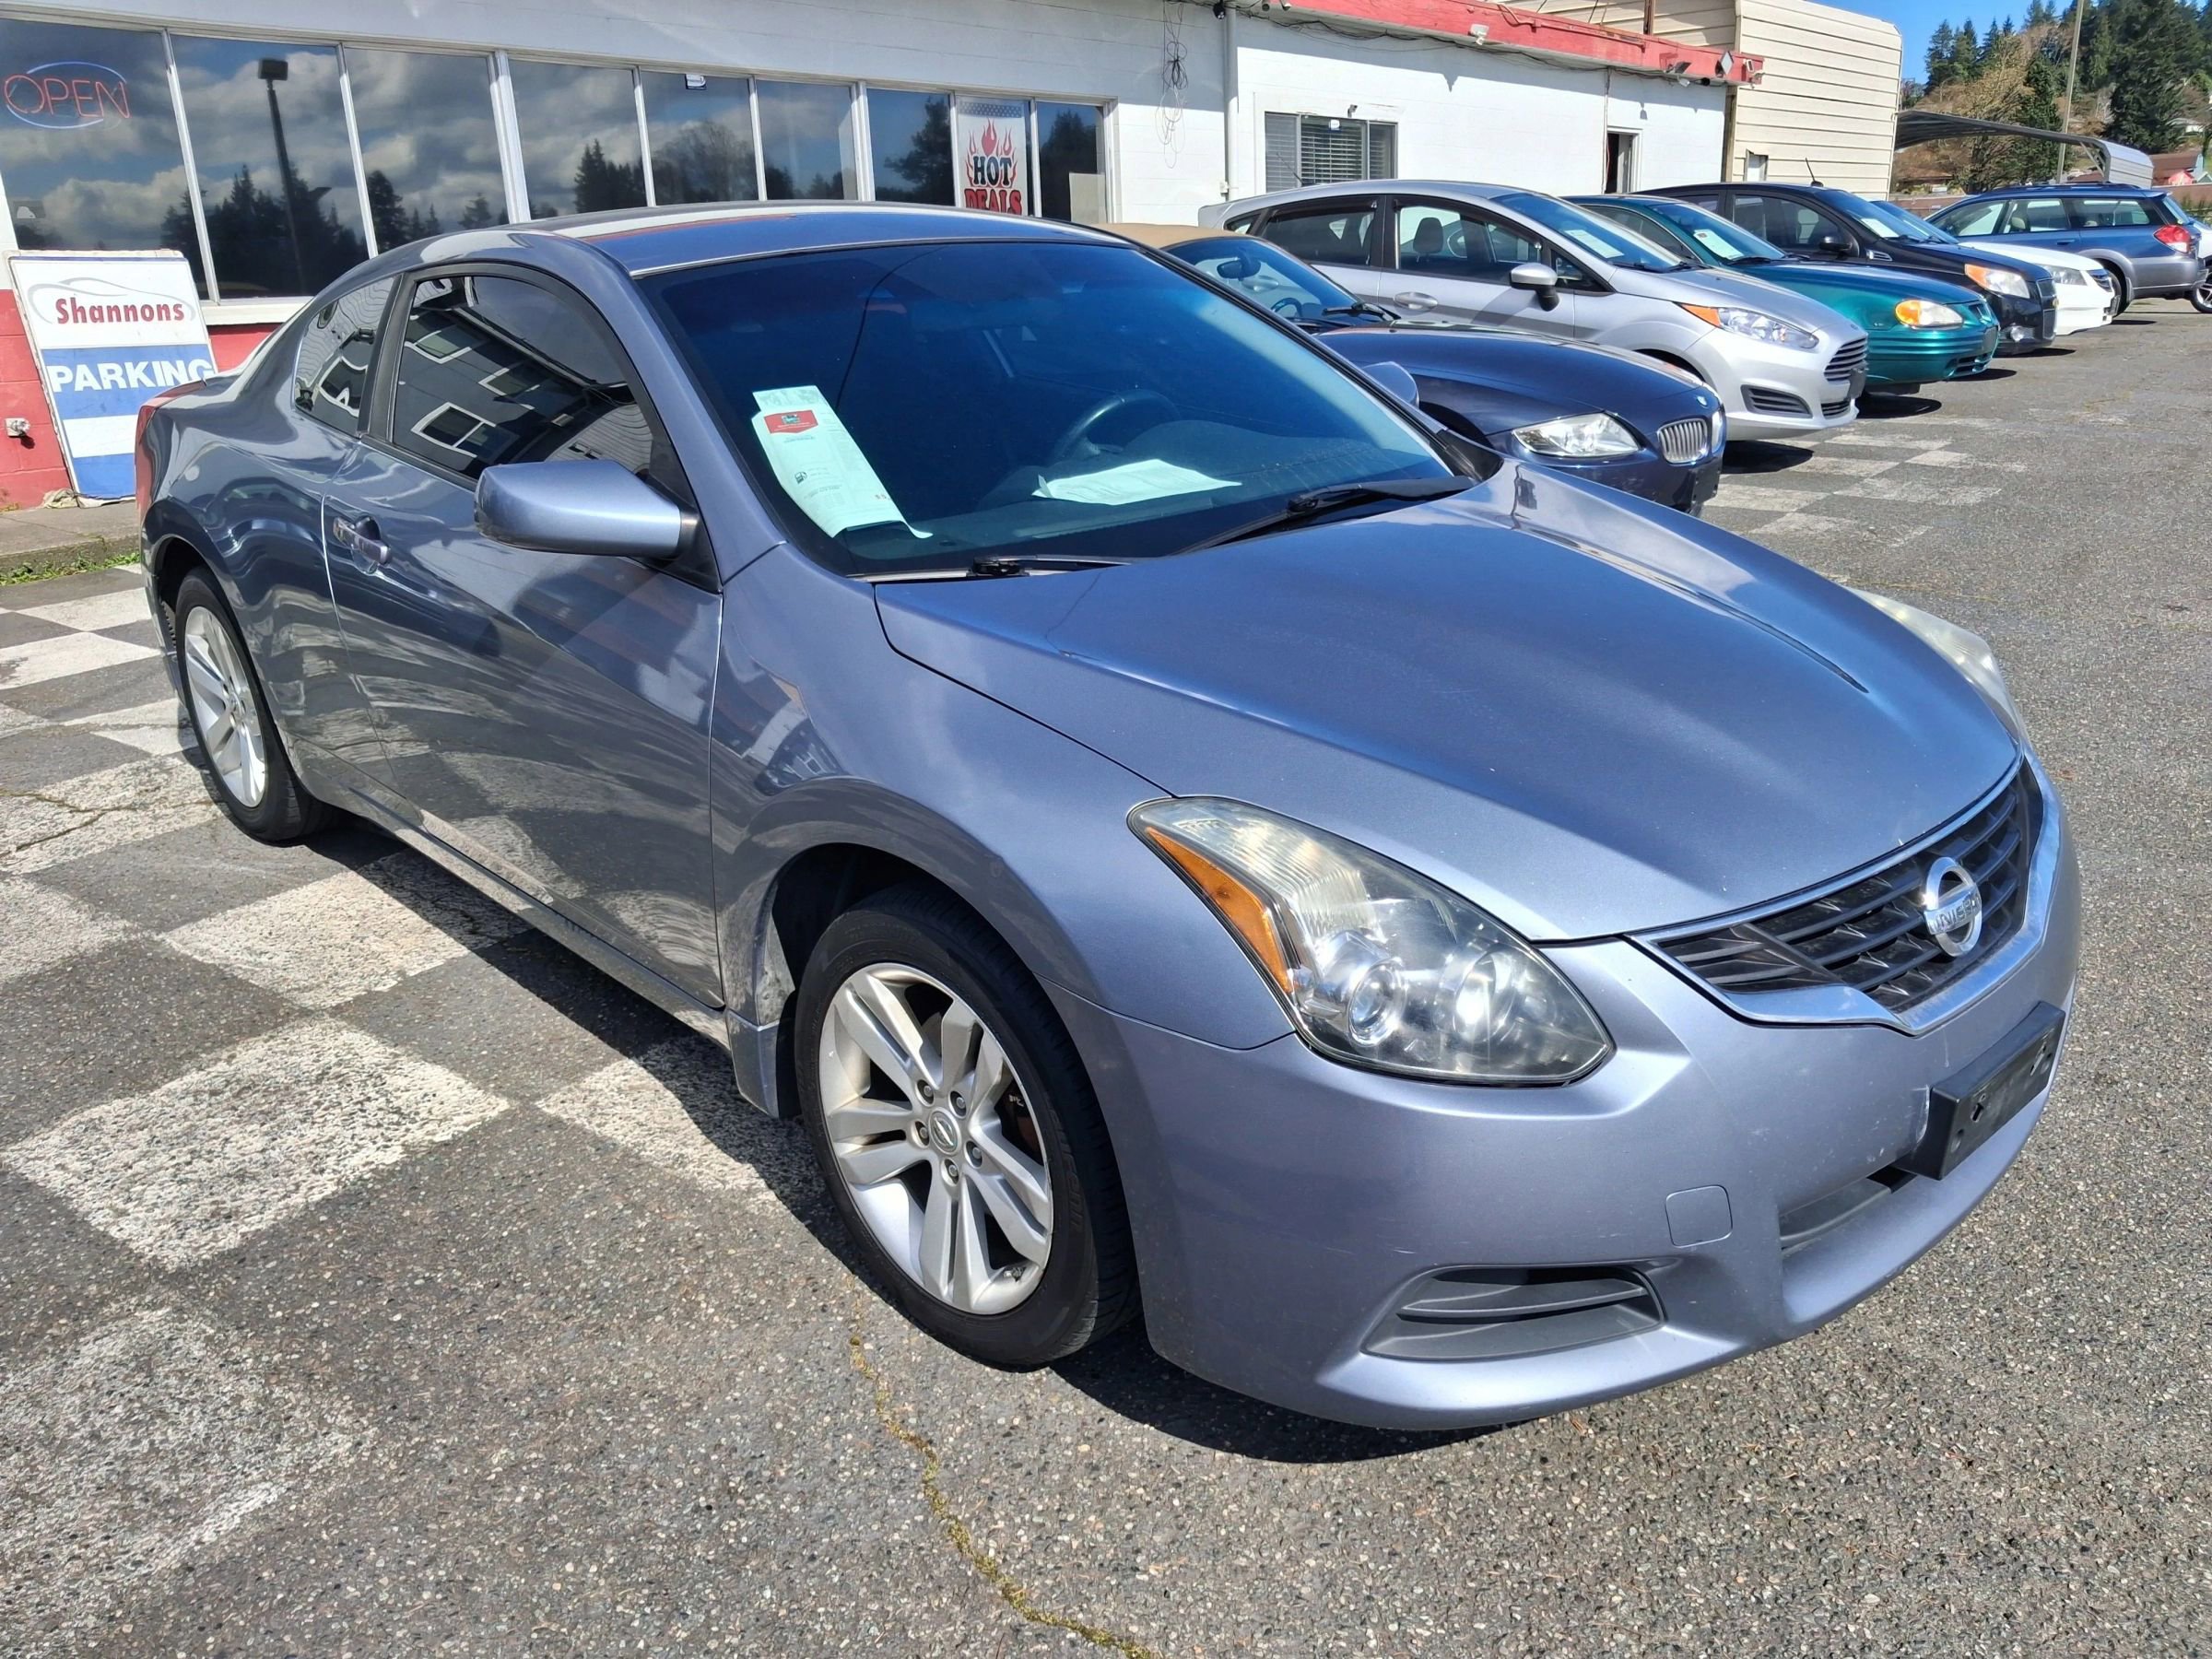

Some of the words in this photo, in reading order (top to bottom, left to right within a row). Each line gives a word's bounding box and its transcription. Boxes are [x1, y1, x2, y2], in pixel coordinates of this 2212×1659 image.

[4, 74, 131, 119] OPEN
[972, 156, 1012, 186] HOT
[964, 188, 1023, 216] DEALS
[55, 297, 185, 324] Shannons
[46, 359, 216, 393] PARKING
